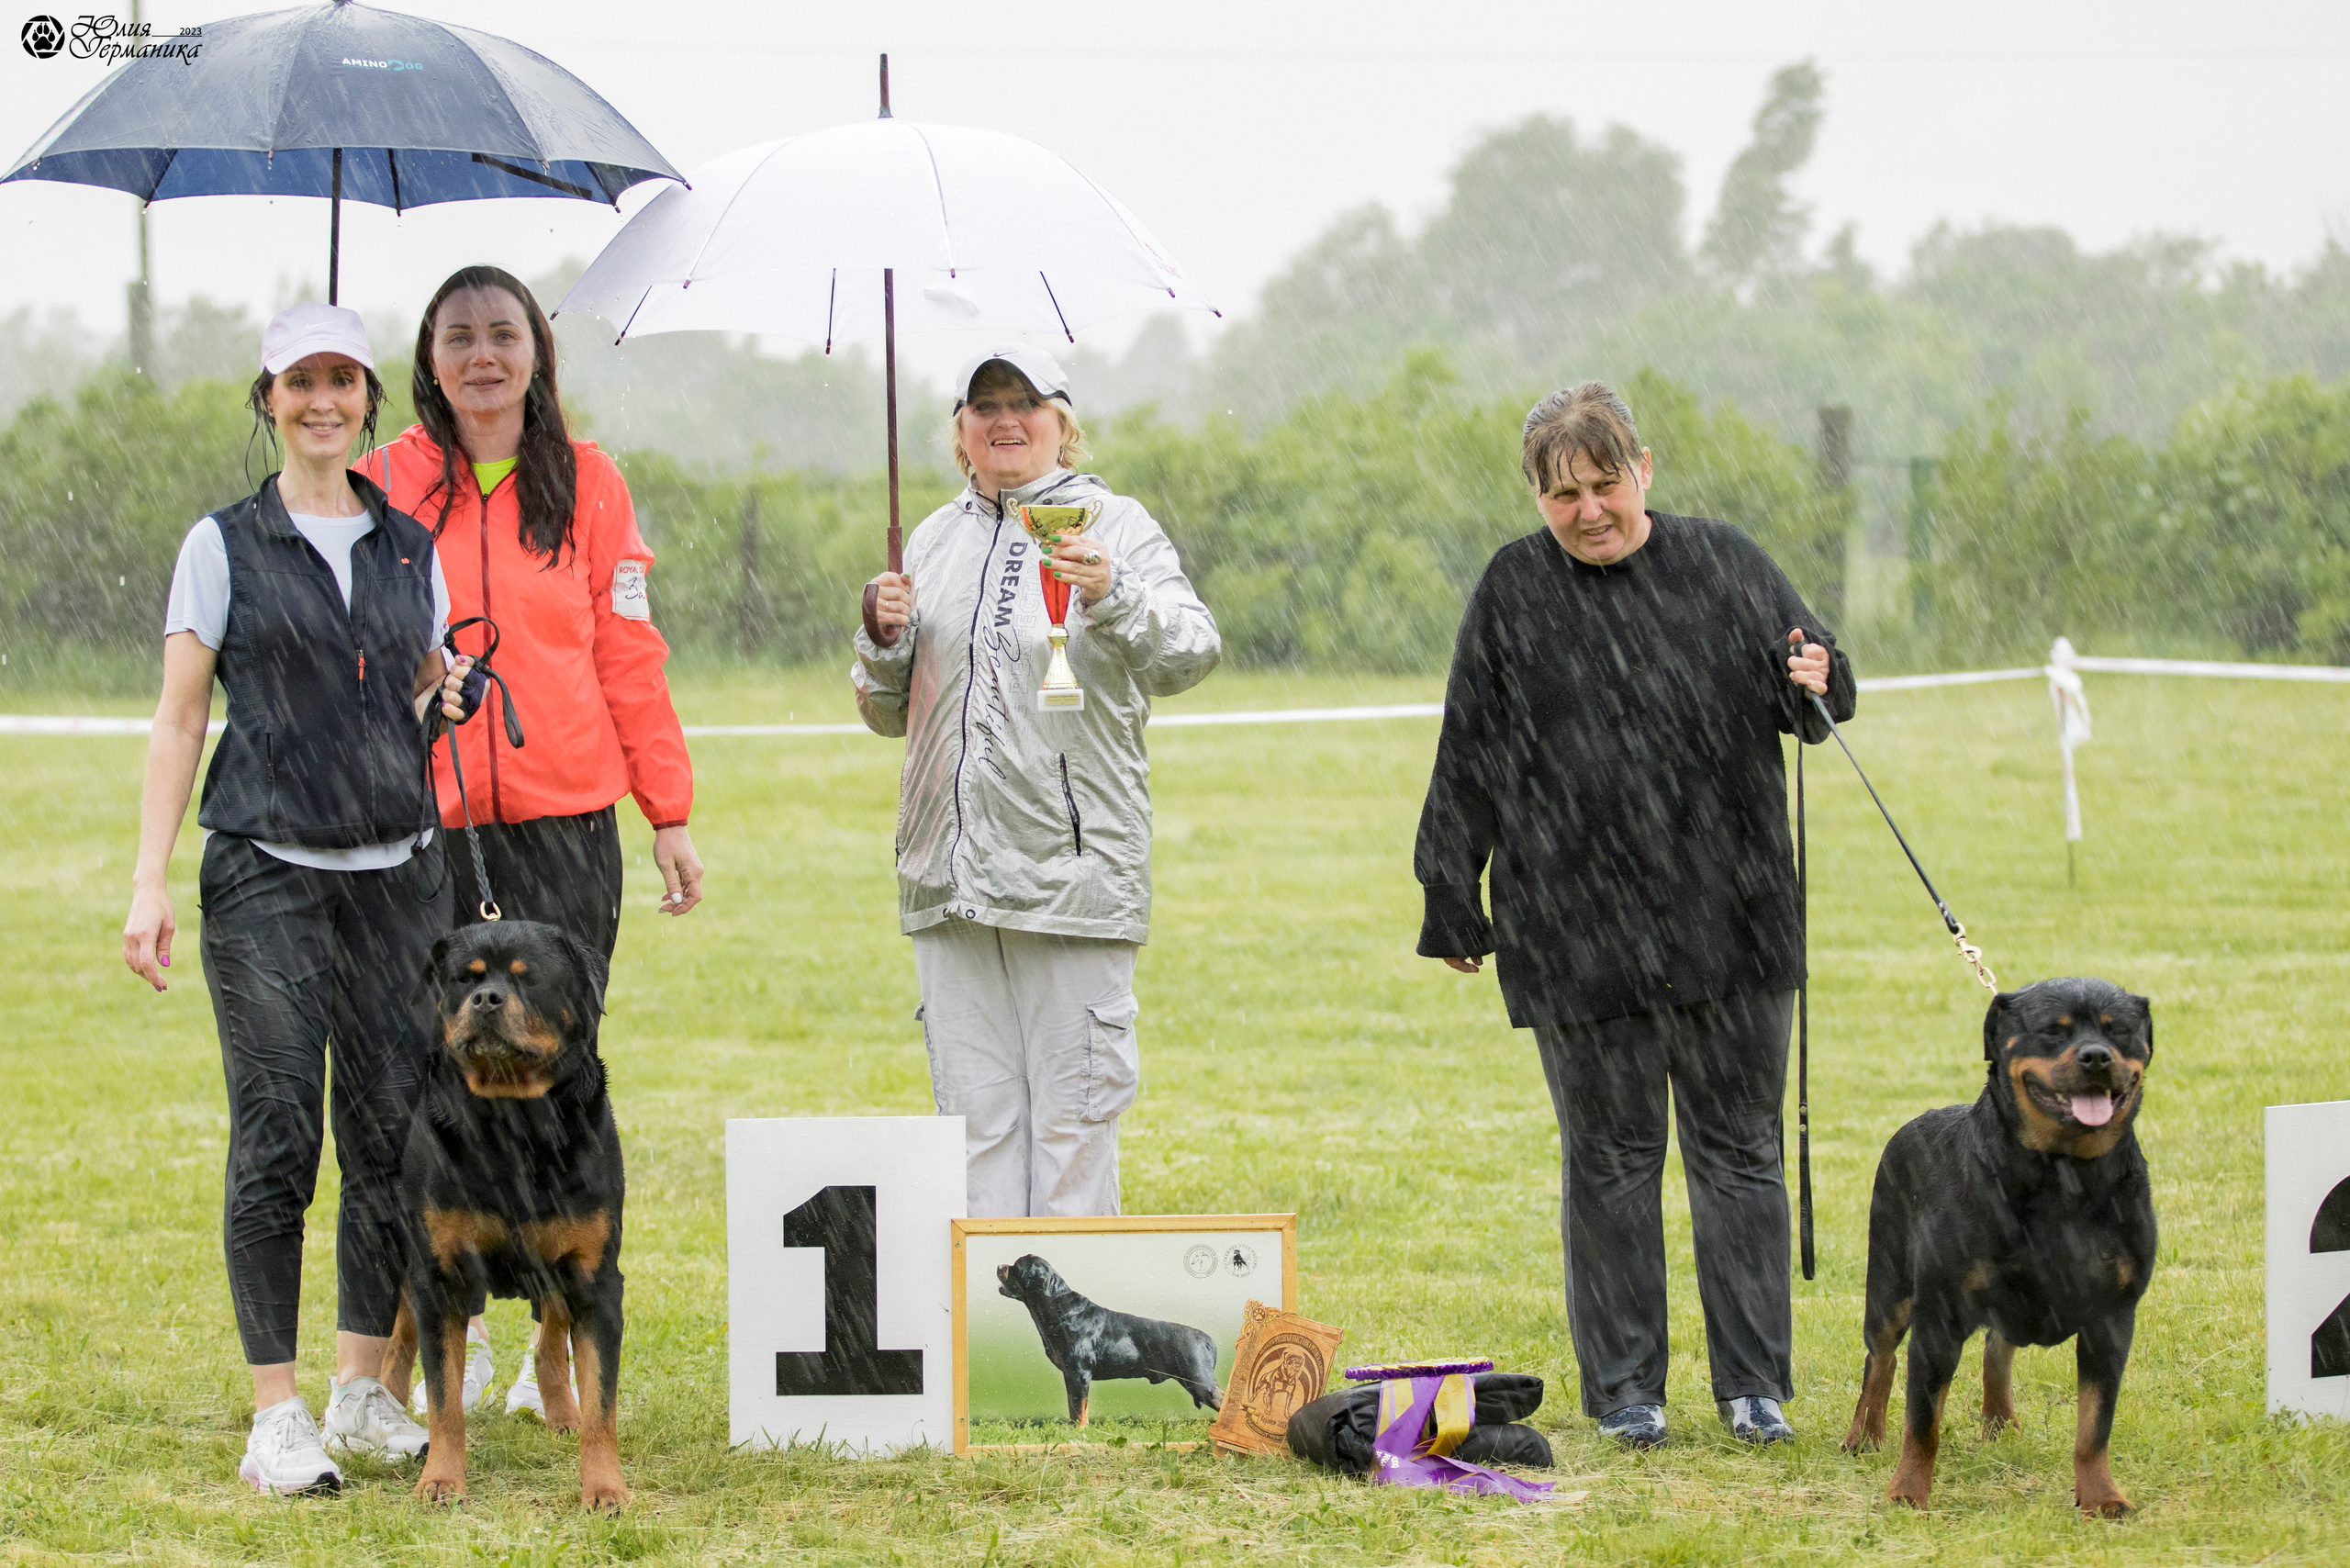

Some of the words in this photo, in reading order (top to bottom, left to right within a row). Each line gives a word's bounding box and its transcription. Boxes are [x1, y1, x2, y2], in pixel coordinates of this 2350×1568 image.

[994, 542, 1028, 627] DREAM
[976, 625, 1021, 779] Beautiful
[776, 1185, 923, 1395] 1
